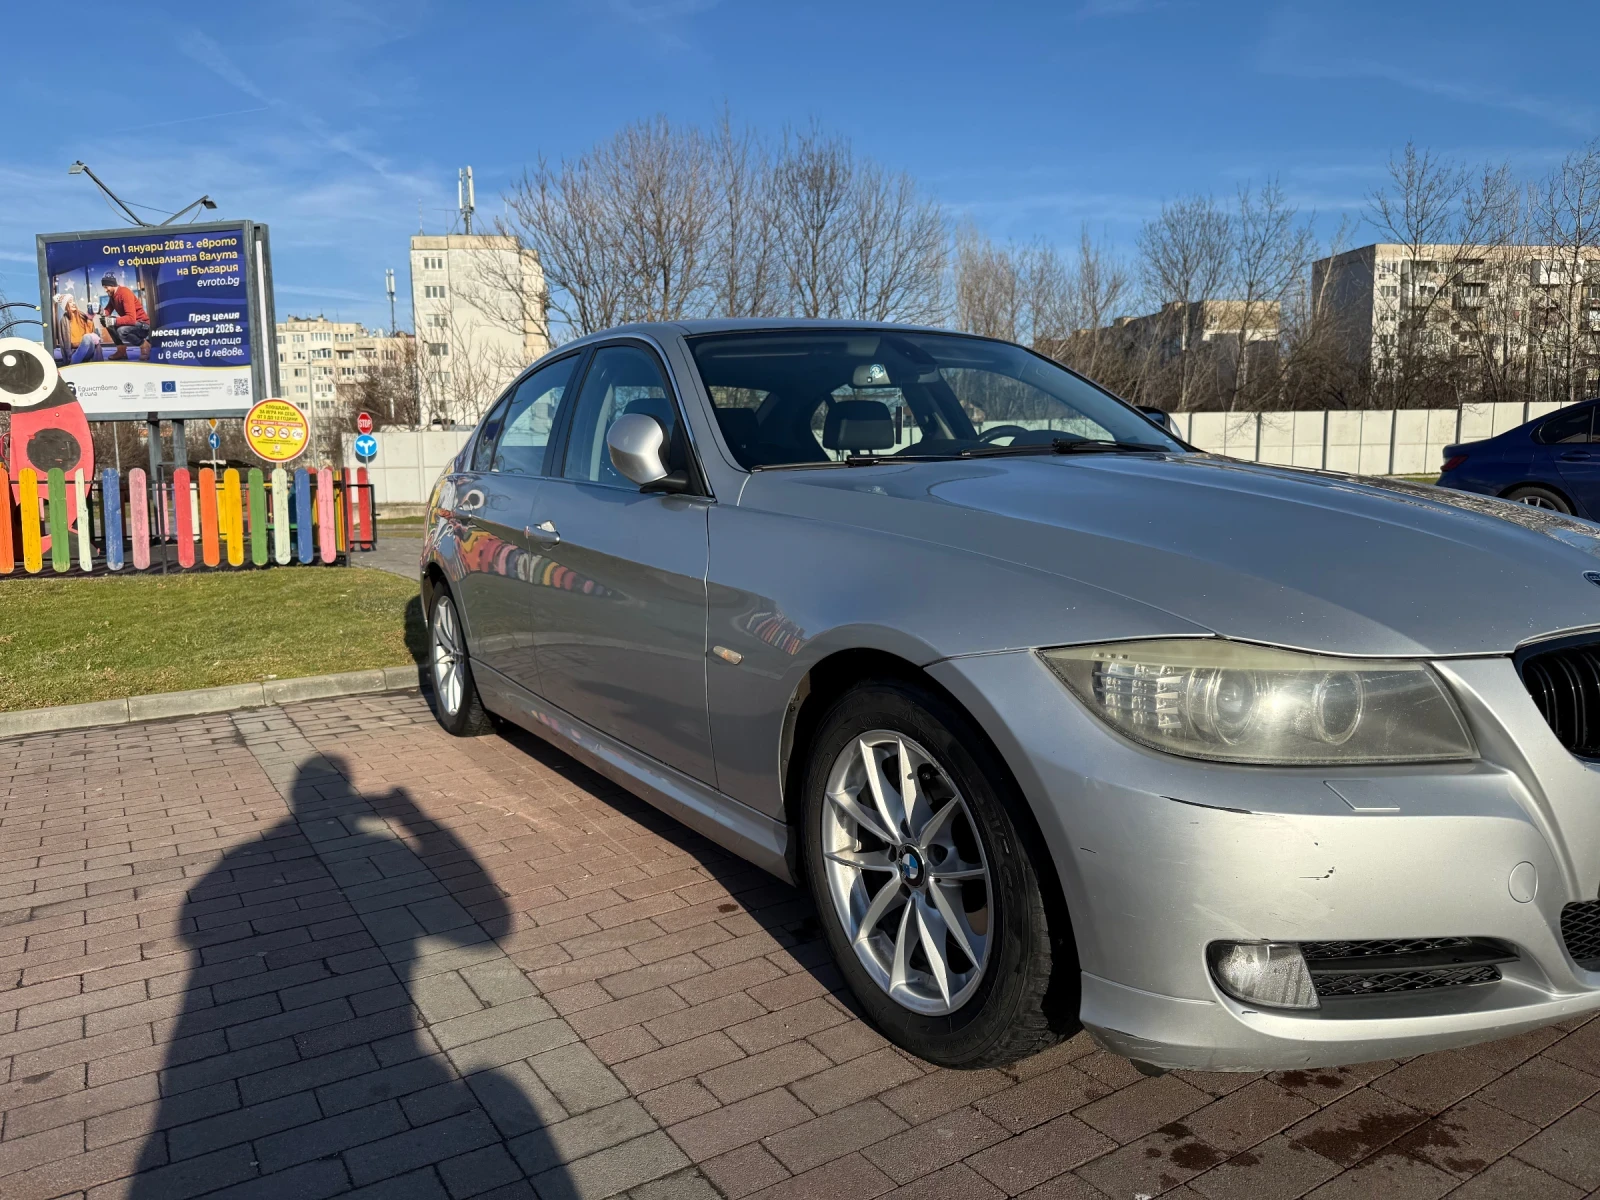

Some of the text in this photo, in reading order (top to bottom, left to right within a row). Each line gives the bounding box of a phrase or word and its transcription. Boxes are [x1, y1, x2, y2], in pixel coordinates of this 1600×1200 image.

[103, 238, 237, 254] От 1 януари 2026 г. еврото
[127, 252, 197, 267] официалната
[199, 251, 238, 261] валута
[177, 264, 239, 276] на България
[197, 276, 240, 287] evroto.bg
[188, 312, 240, 323] През целия
[151, 329, 179, 337] месец
[181, 327, 214, 337] януари
[215, 323, 234, 333] 2026
[161, 339, 185, 348] може
[186, 339, 198, 349] да
[211, 337, 242, 345] плаща
[165, 350, 171, 359] в
[172, 350, 196, 360] евро,
[197, 350, 203, 358] и
[204, 348, 211, 357] в
[211, 347, 245, 357] левове.
[78, 384, 118, 392] Единството
[359, 419, 371, 428] STOP
